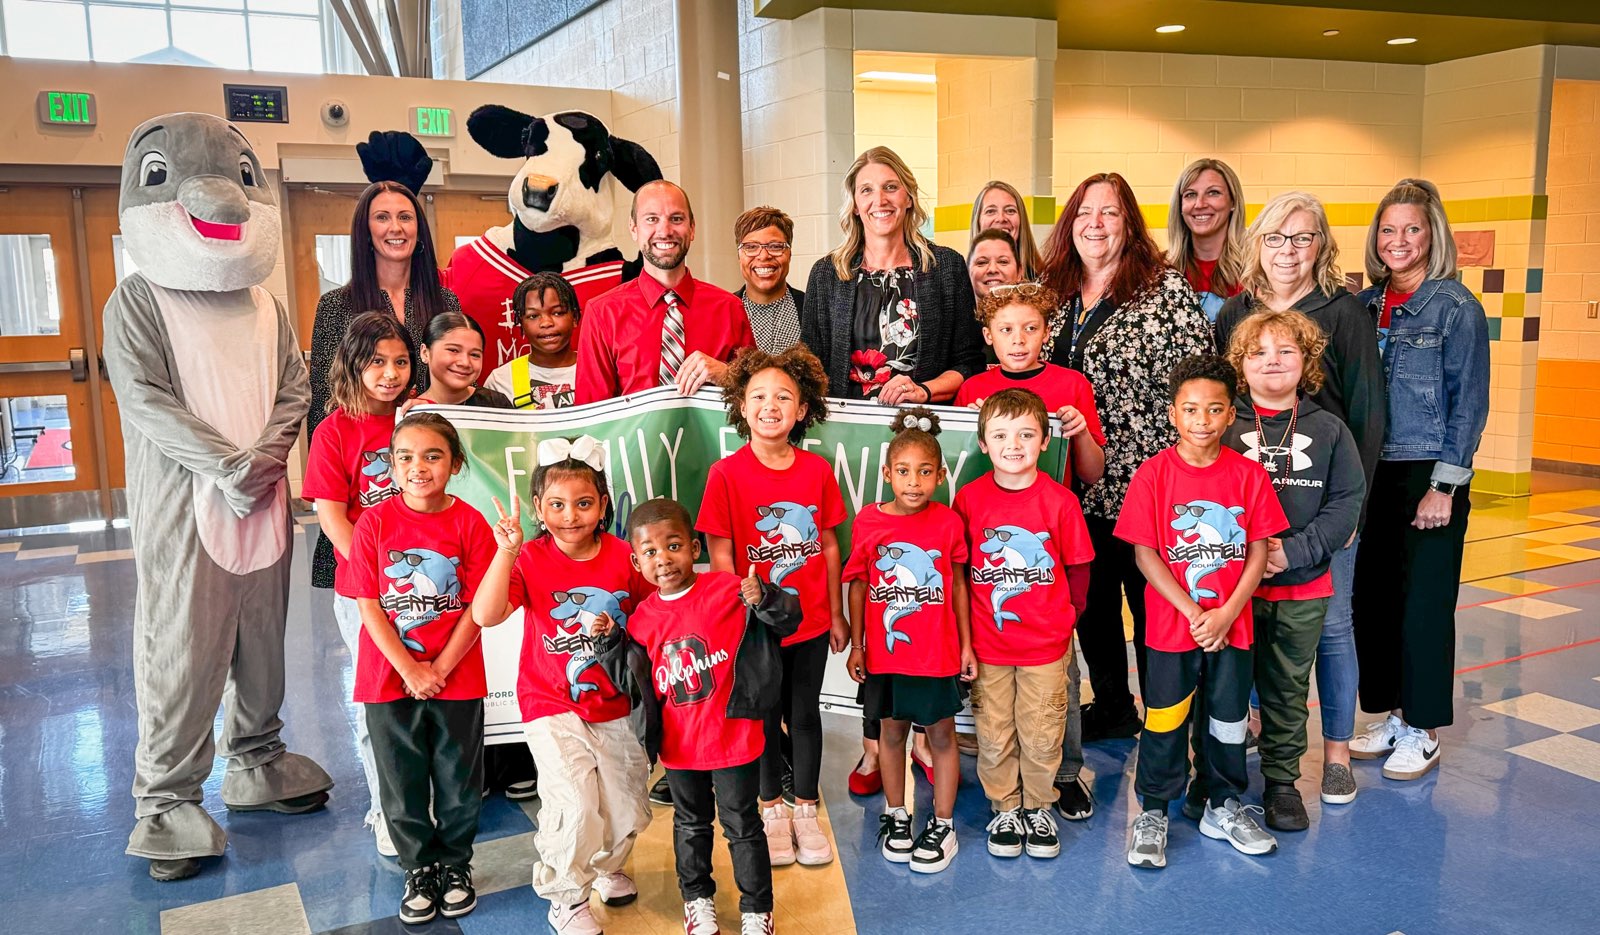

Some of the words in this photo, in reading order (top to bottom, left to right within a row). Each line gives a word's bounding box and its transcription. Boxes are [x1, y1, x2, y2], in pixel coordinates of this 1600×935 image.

[48, 92, 90, 123] EXIT
[416, 107, 450, 135] EXIT
[1272, 477, 1323, 488] ARMOUR
[747, 541, 822, 562] DEERFIELD
[971, 566, 1055, 585] DEERFIELD
[869, 585, 944, 604] DEERFIELD
[656, 648, 728, 693] Dolphins
